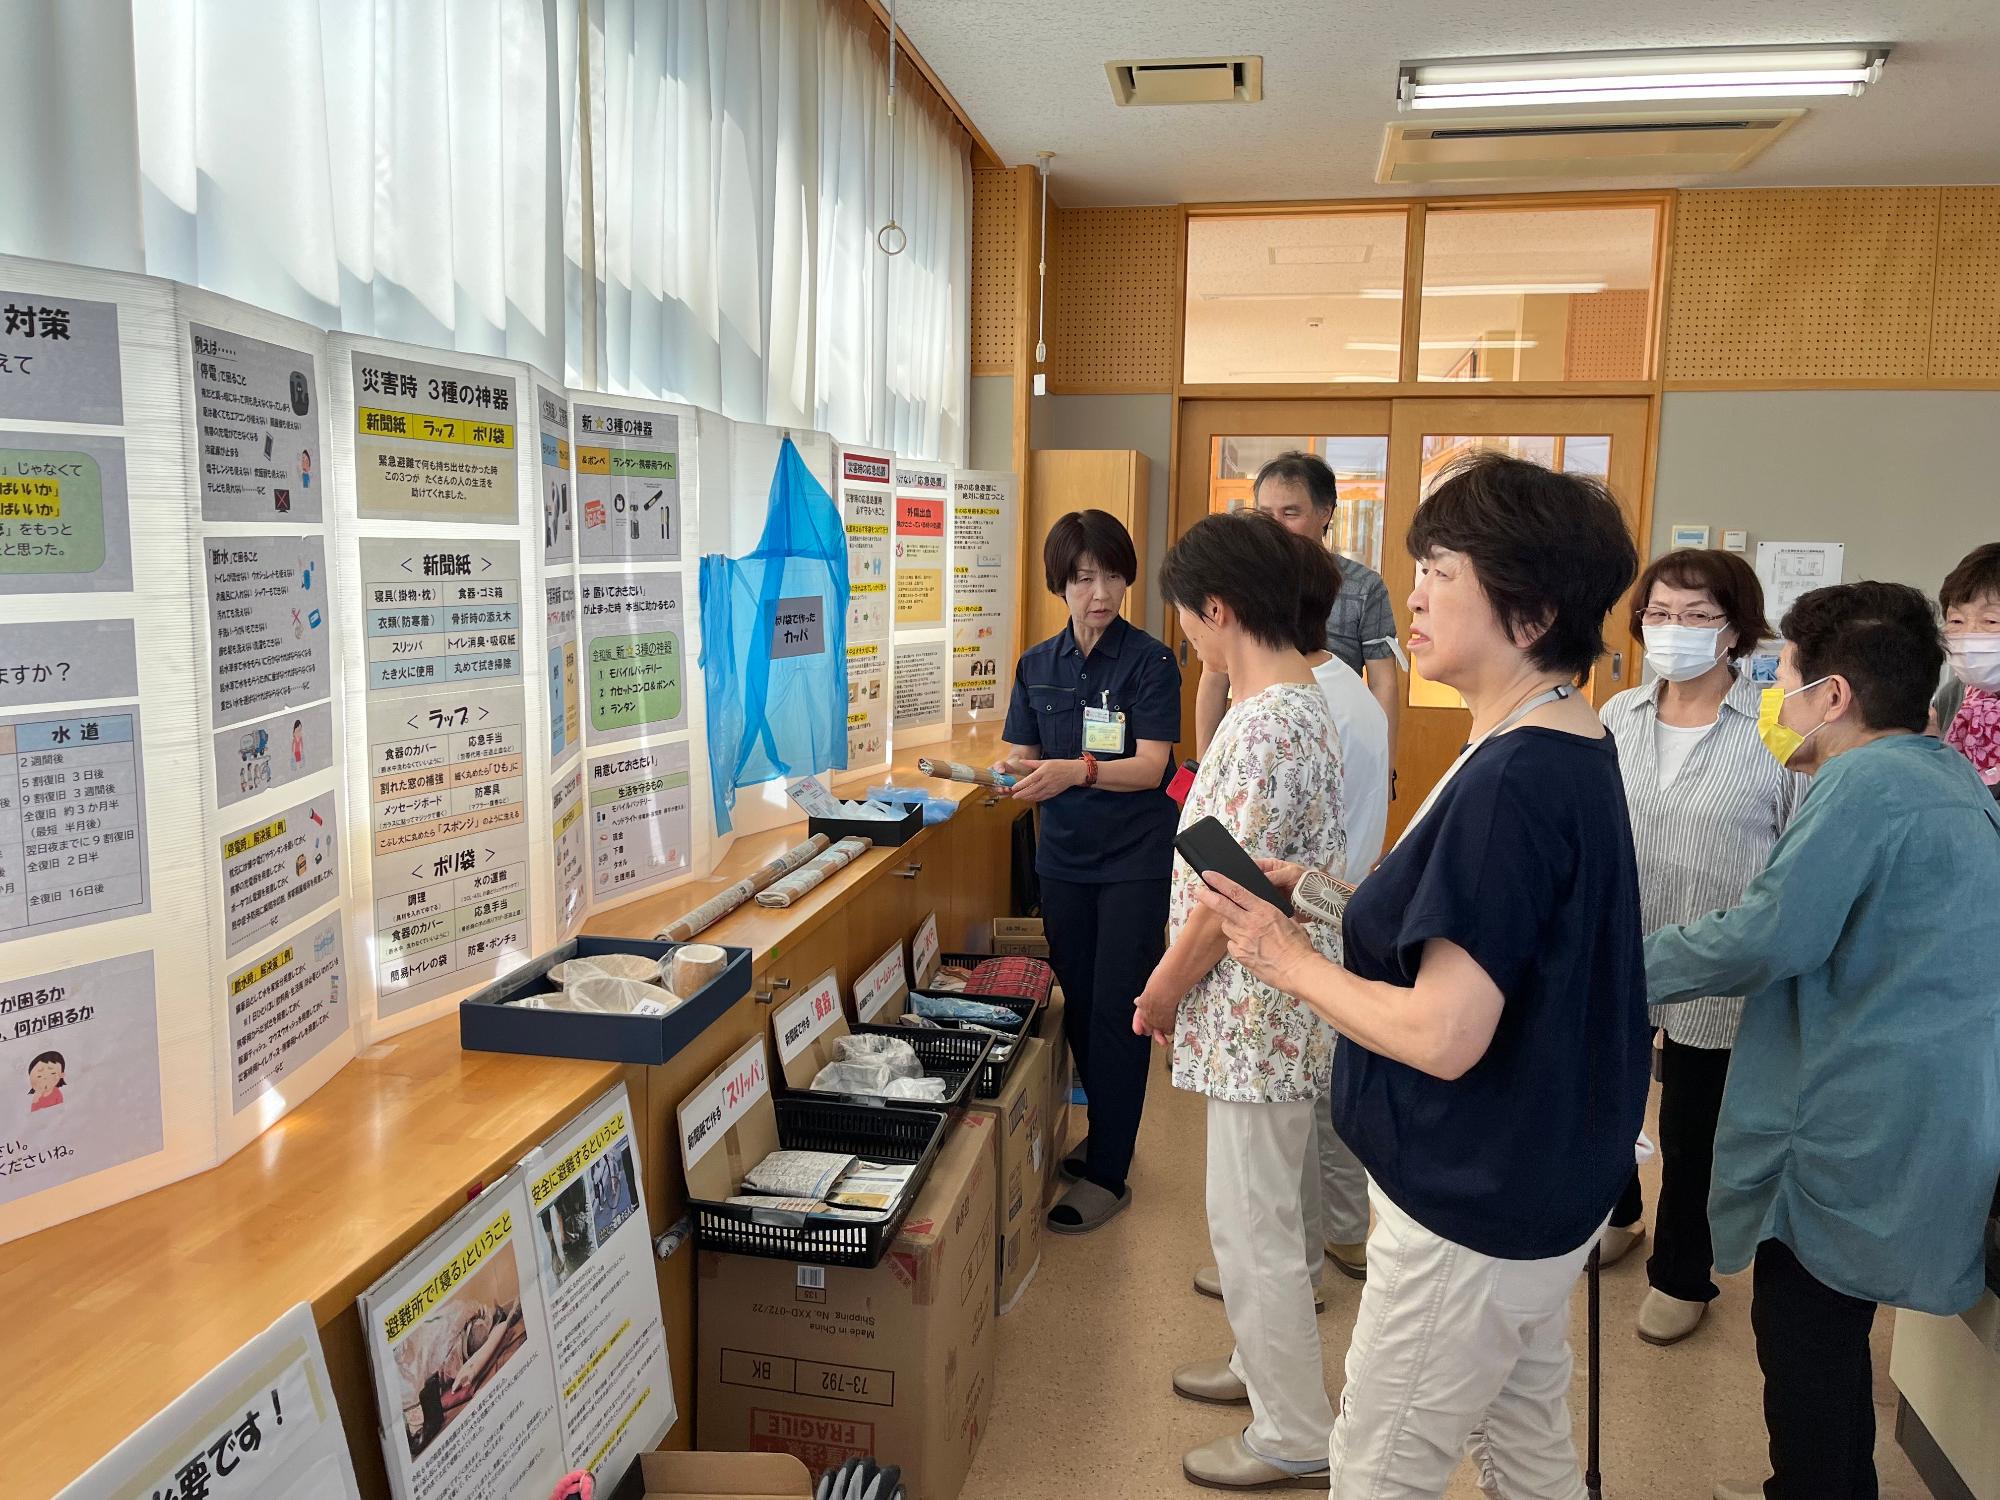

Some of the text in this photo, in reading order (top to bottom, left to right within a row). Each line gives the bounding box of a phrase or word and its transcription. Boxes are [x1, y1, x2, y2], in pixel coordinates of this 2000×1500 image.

[4, 304, 71, 340] 対策
[361, 367, 509, 411] 災害時 3種の神器
[366, 412, 406, 434] 新聞紙
[423, 420, 455, 438] ラップ
[473, 426, 505, 444] ポリ袋
[378, 454, 498, 475] 緊急避難で何も持ち出せなかった時
[384, 471, 493, 489] この3つが たくさんの人の生活を
[411, 487, 468, 500] 助けてくれました。
[423, 553, 472, 576] 新聞紙
[458, 587, 503, 600] 食器・ゴミ箱
[451, 610, 512, 625] 骨折時の添え木
[447, 634, 516, 650] トイレ消臭・吸収紙
[784, 628, 809, 644] カッパ
[392, 640, 423, 653] スリッパ
[381, 665, 434, 680] たき火に使用
[454, 658, 512, 674] 丸めて拭き掃除
[610, 701, 636, 714] ランタン
[429, 706, 469, 729] ラップ
[52, 723, 100, 744] 水道
[468, 732, 503, 747] 応急手当
[385, 744, 437, 761] 食器のカバー
[380, 773, 444, 795] 割れた窓の補強
[475, 783, 501, 798] 防寒具
[618, 779, 664, 798] 生活を守るもの
[384, 795, 442, 816] メッセージボード
[24, 808, 57, 823] 全復旧
[27, 858, 60, 873] 全復旧
[433, 848, 476, 877] ポリ袋
[30, 892, 62, 907] 全復旧
[407, 891, 426, 907] 調理
[474, 898, 508, 917] 応急手当
[391, 920, 444, 943] 食器のカバー
[467, 933, 517, 957] 防寒・ポンチョ
[390, 954, 447, 983] 簡易トイレの袋
[687, 1105, 722, 1151] 新聞紙で作る
[531, 1115, 625, 1206] 安全に避難するということ
[384, 1214, 513, 1343] 避難所で「寝る」ということ
[809, 1322, 875, 1340] Made in China
[752, 1359, 771, 1380] BK
[821, 1371, 869, 1395] 73-792
[768, 1414, 856, 1444] FRAGILE
